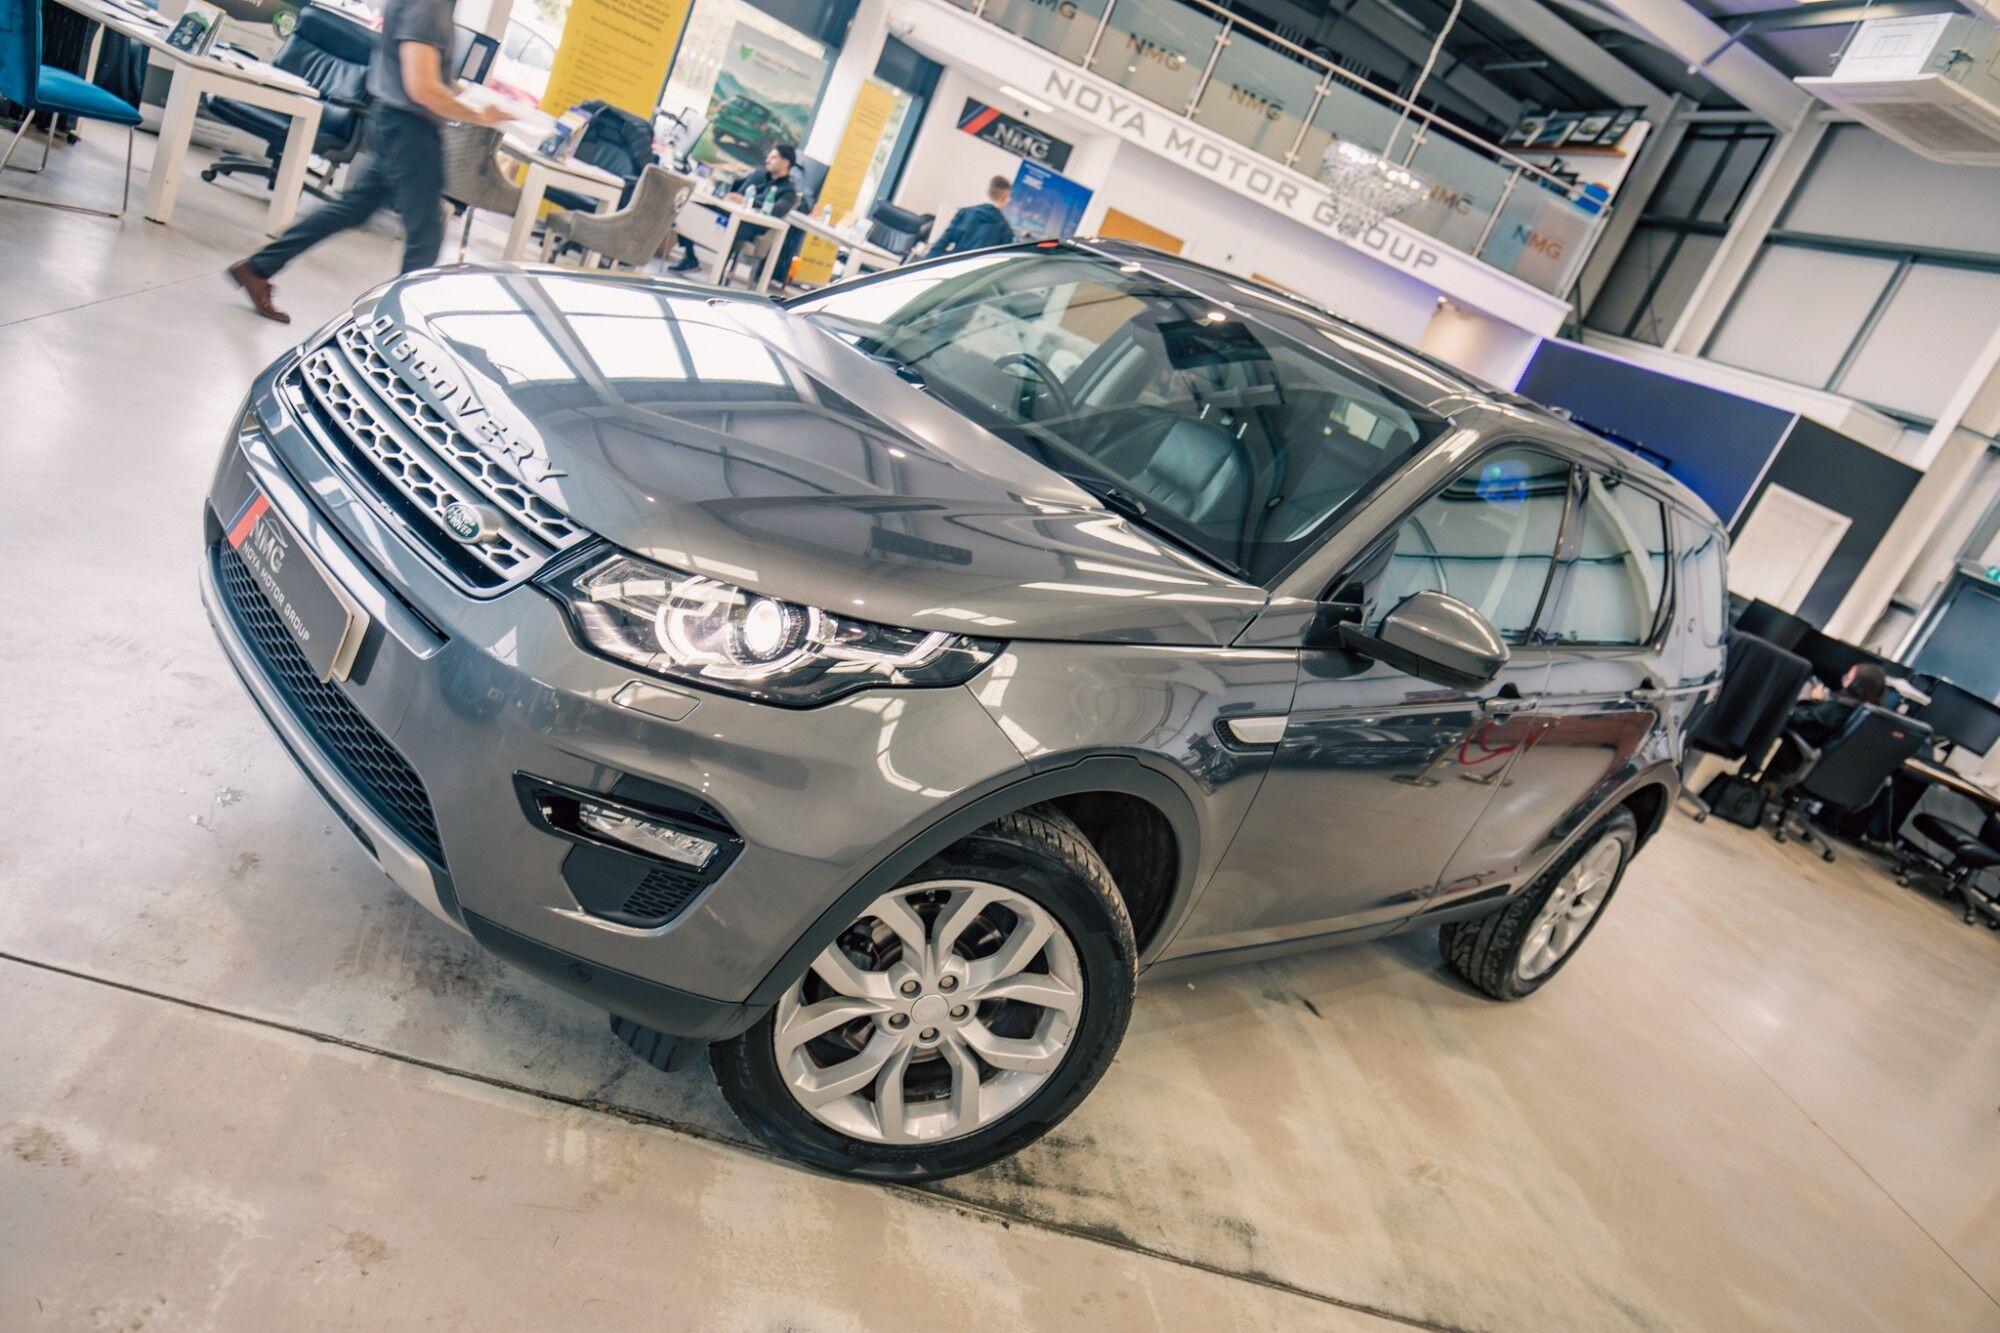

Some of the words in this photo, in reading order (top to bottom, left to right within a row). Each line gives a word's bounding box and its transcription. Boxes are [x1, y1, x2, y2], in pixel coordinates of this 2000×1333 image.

[1029, 0, 1077, 19] MG
[1125, 33, 1182, 71] NMG
[1228, 83, 1283, 121] NMG
[991, 122, 1050, 159] NMG
[1044, 69, 1146, 138] NOYA
[1164, 128, 1299, 208] MOTOR
[1313, 201, 1437, 268] GOUP
[1512, 225, 1563, 260] NMG
[370, 314, 569, 482] DISCOVERY
[249, 513, 286, 574] NMG
[242, 540, 260, 571] NOYA
[260, 568, 285, 606] MOTOR
[284, 603, 310, 642] GROUP
